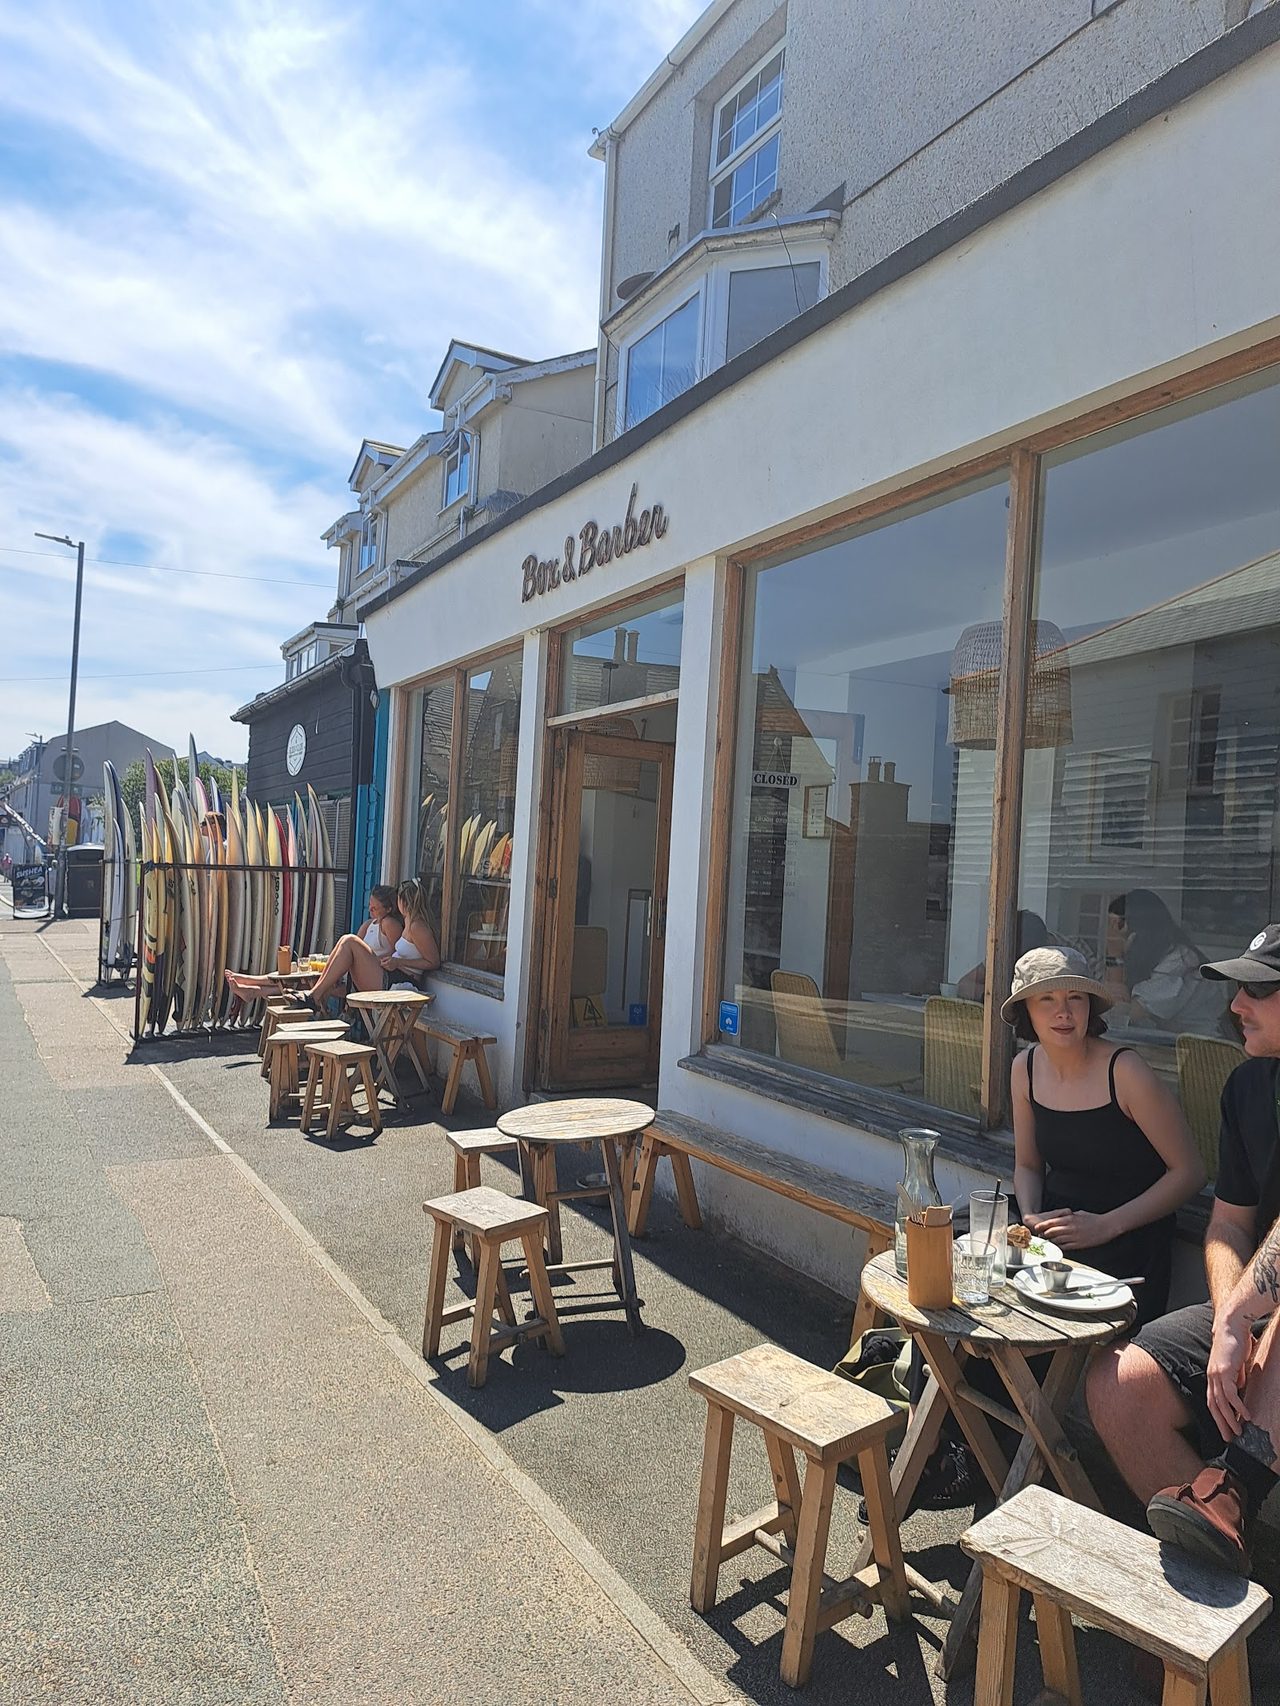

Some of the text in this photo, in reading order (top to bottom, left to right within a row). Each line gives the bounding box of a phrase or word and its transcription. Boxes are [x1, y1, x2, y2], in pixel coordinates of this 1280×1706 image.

[521, 482, 668, 603] Box & Barber
[753, 773, 798, 786] CLOSED
